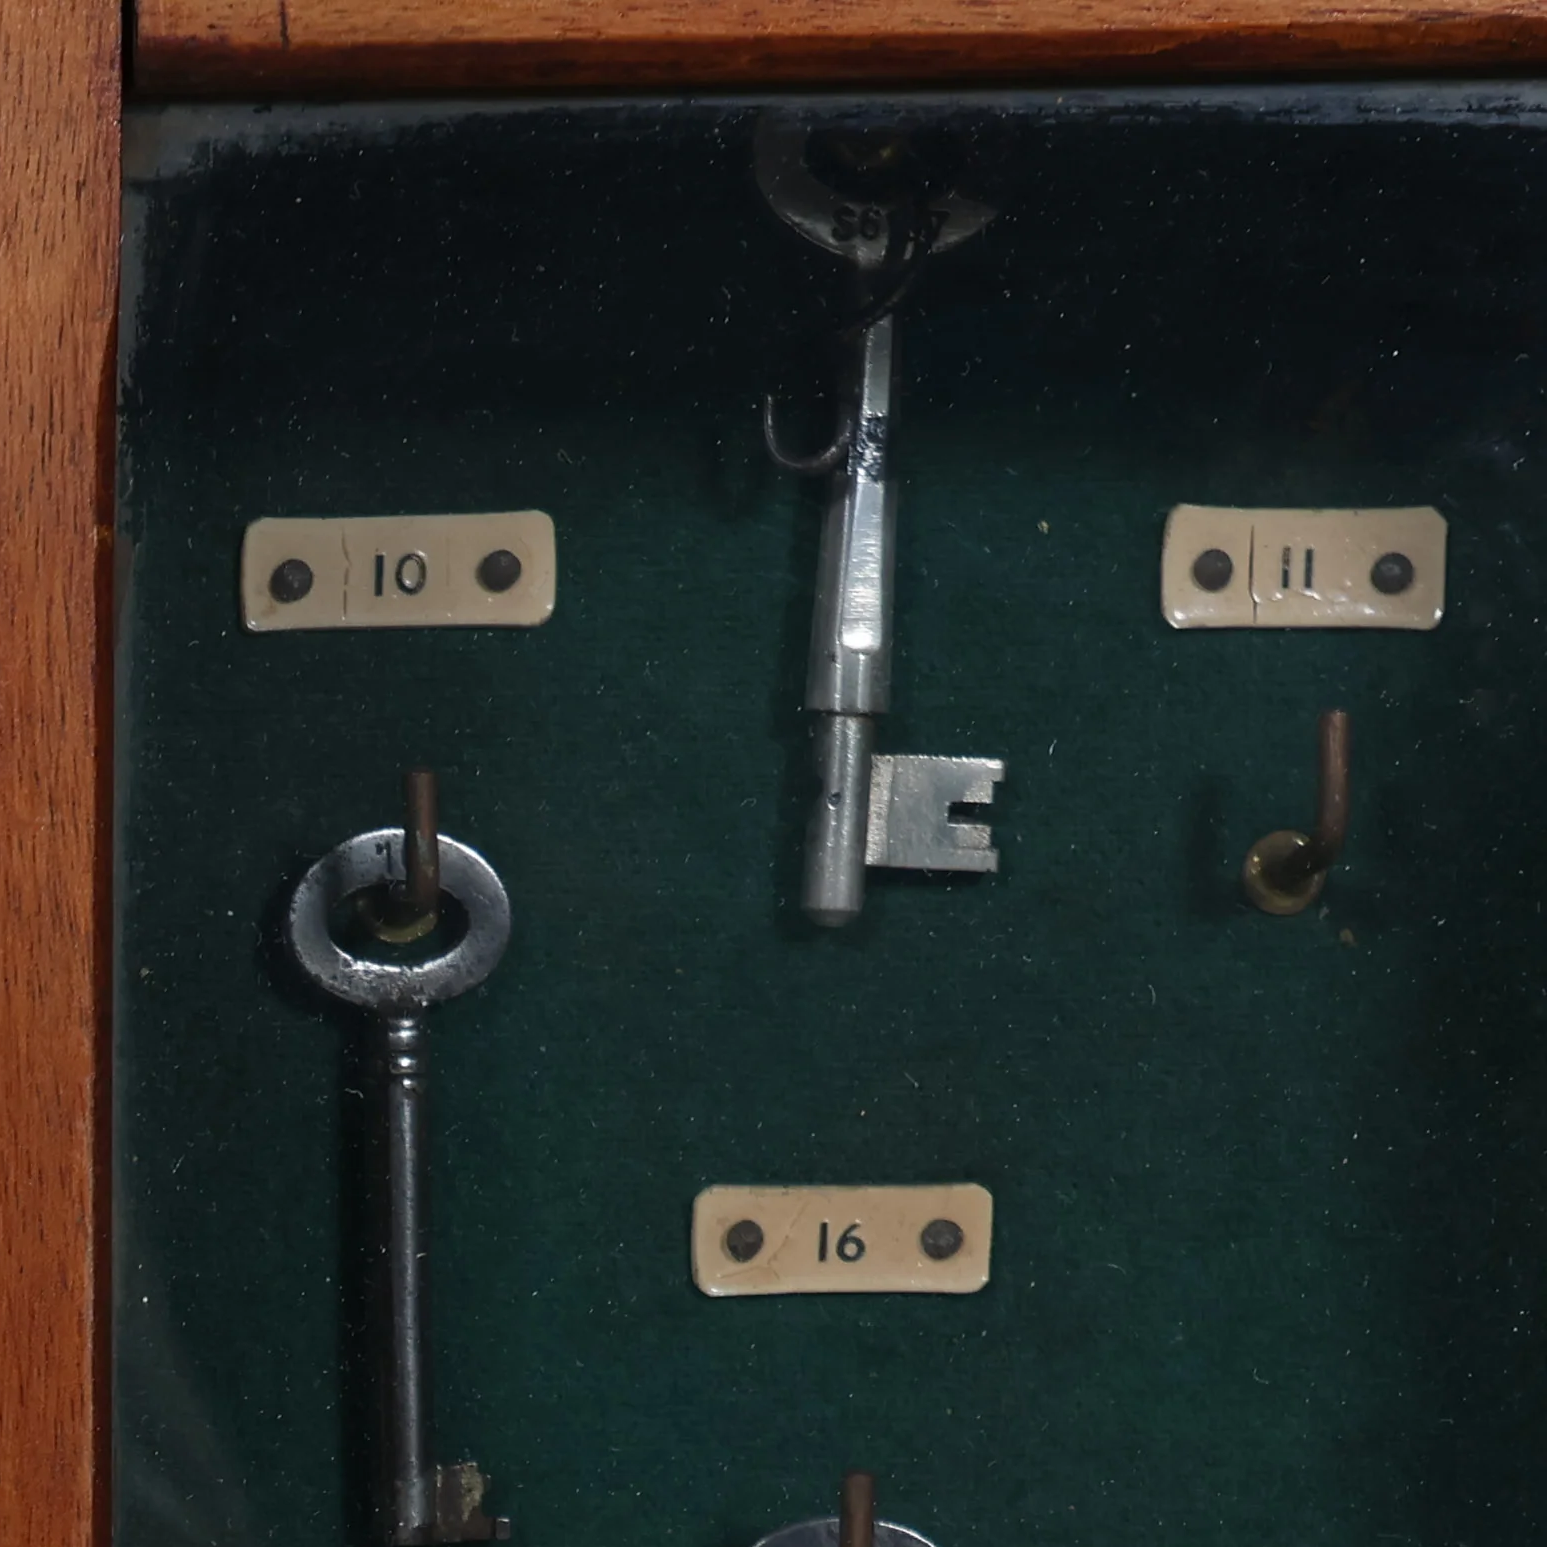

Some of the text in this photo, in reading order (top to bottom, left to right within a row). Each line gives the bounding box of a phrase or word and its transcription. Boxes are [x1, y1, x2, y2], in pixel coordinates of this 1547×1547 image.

[373, 552, 428, 598] 10
[1279, 544, 1316, 592] 11
[817, 1221, 867, 1264] 16
